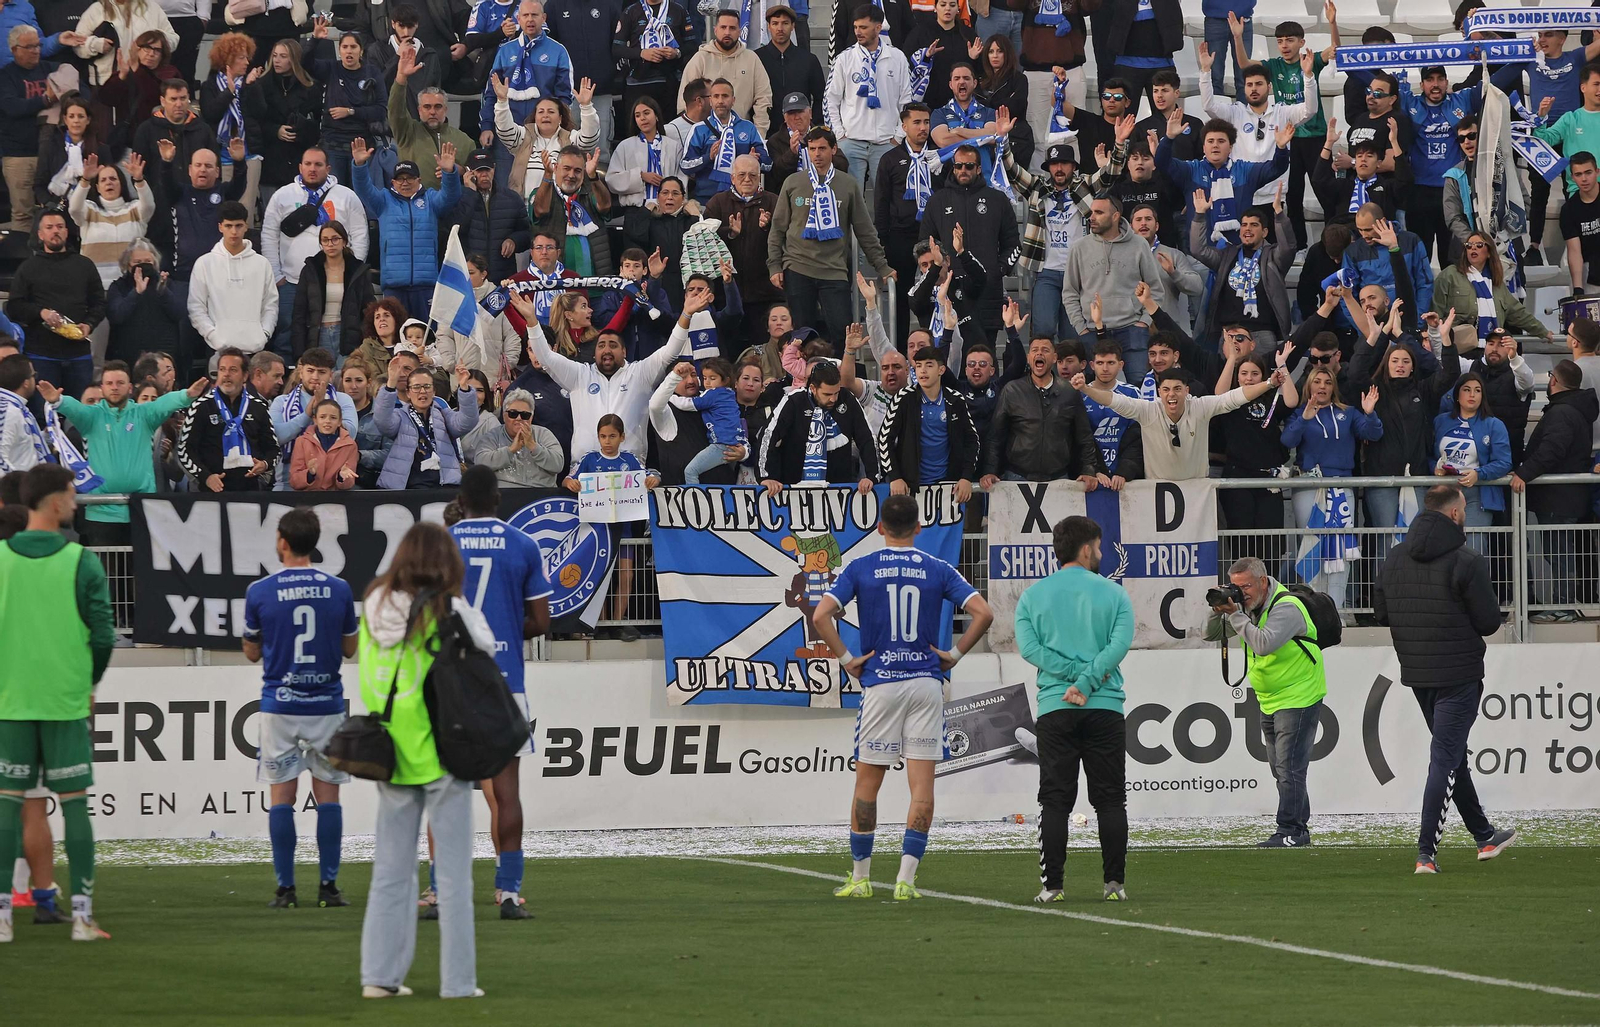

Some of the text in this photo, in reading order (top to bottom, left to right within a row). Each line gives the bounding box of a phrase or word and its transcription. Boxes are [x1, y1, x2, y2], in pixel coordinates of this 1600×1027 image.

[1473, 13, 1505, 25] AYAS
[1508, 12, 1549, 24] DONDE
[1552, 11, 1592, 23] VAYAS
[1341, 43, 1531, 64] KOLECTIVO SUR
[819, 196, 832, 226] SIGO
[562, 276, 635, 291] SHERRY
[1105, 426, 1120, 436] Air
[1452, 450, 1469, 460] Air
[580, 472, 641, 495] ILIAS
[651, 483, 964, 531] KOLECTIVO UR
[1017, 482, 1186, 534] X D
[453, 526, 490, 535] indeso
[460, 536, 506, 550] MWANZA
[879, 553, 910, 562] indeso
[1000, 544, 1199, 578] SHERR PRIDE
[277, 574, 313, 583] indeso
[469, 556, 493, 612] 7
[874, 566, 927, 580] SERGIO GARCÍA
[277, 586, 331, 602] MARCELO
[886, 583, 921, 643] 10
[1159, 588, 1187, 640] C
[292, 604, 317, 664] 2
[674, 655, 833, 696] ULTRAS
[944, 694, 1006, 717] ARJETA NARANJA
[1481, 682, 1600, 732] ontig
[1545, 739, 1600, 775] to
[1124, 776, 1258, 793] cotocontigo.pro
[140, 792, 176, 816] EN
[200, 790, 320, 816] ALTUA
